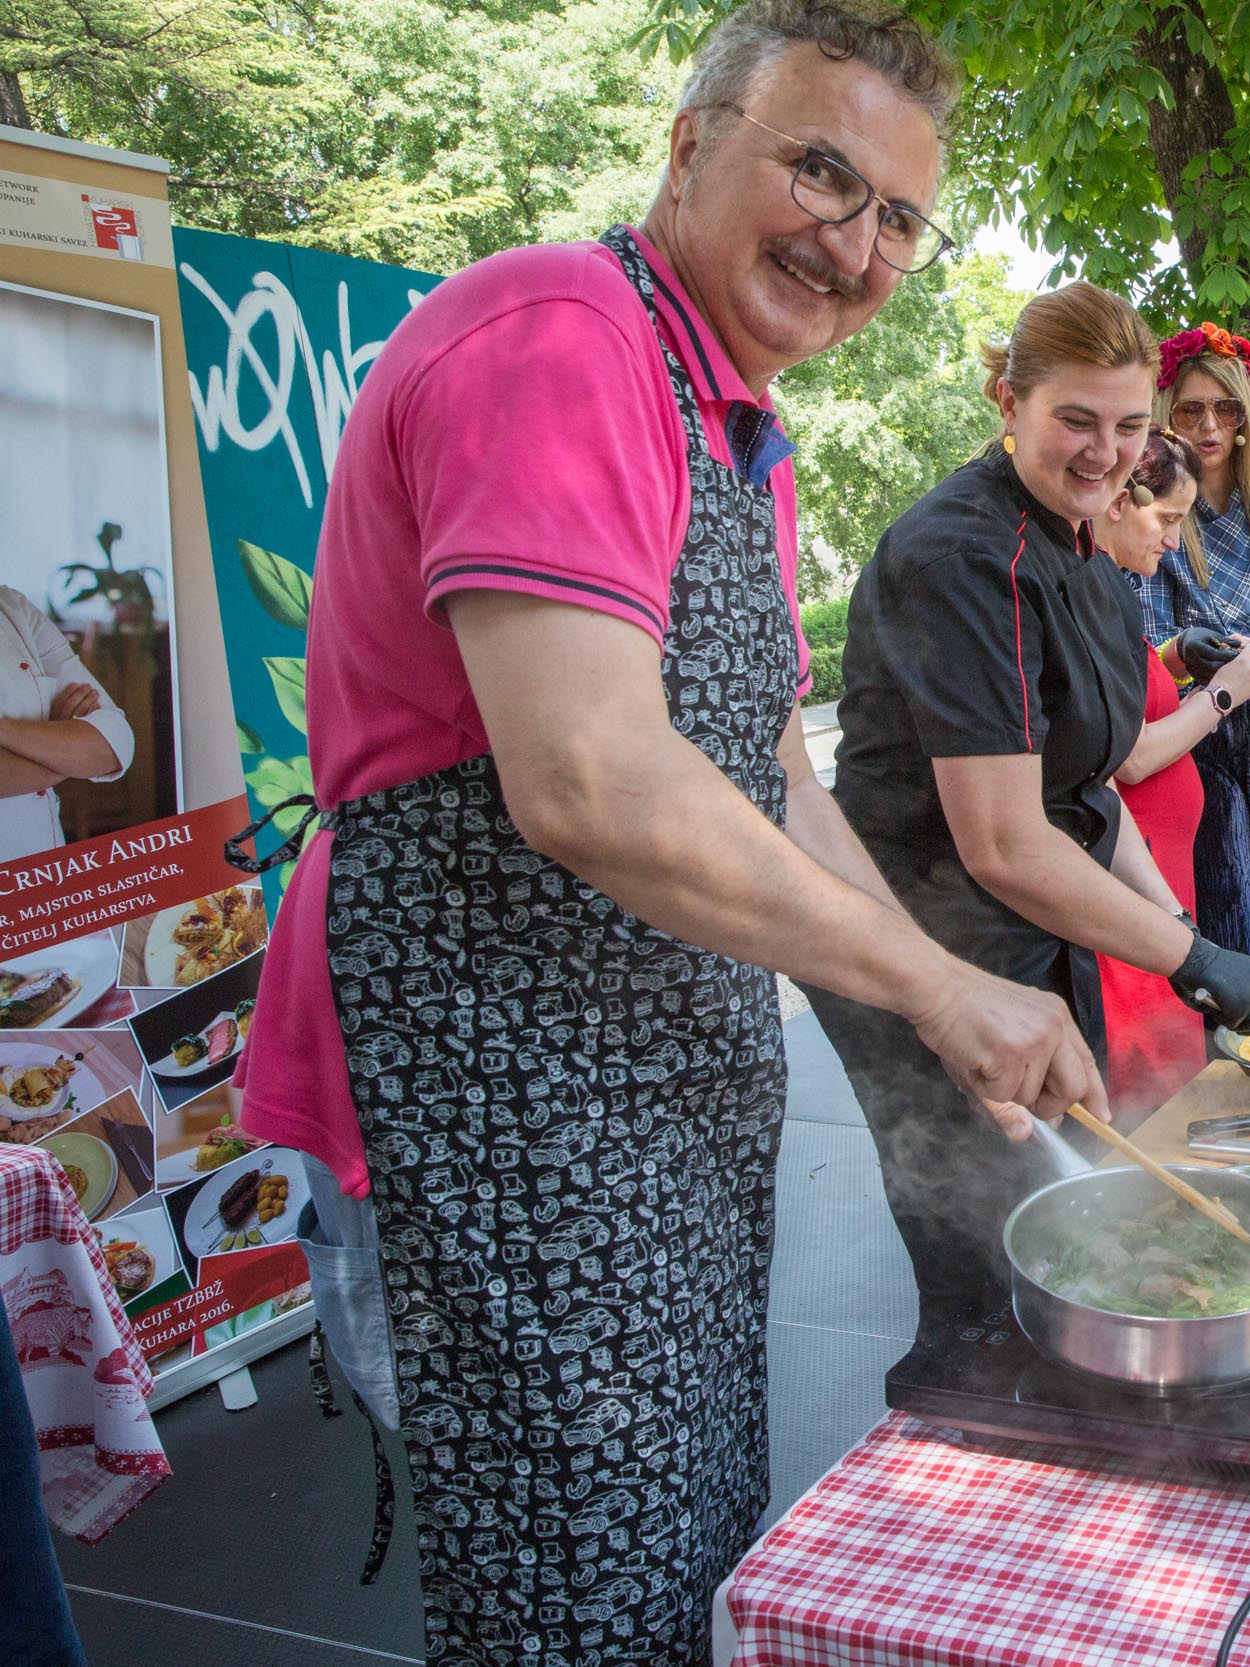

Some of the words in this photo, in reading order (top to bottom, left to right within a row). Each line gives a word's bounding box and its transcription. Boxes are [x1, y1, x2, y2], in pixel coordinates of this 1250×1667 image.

[9, 229, 58, 243] KUHARSKI
[60, 237, 88, 247] SAVEZ
[107, 825, 193, 864] ANDRI
[19, 889, 95, 921] MAJSTOR
[97, 863, 184, 896] SLASTIČAR,
[0, 924, 58, 950] ČITELJ
[62, 893, 156, 931] KUHARSTVA
[173, 1280, 224, 1313] TZBBŽ
[200, 1299, 234, 1323] 2016.
